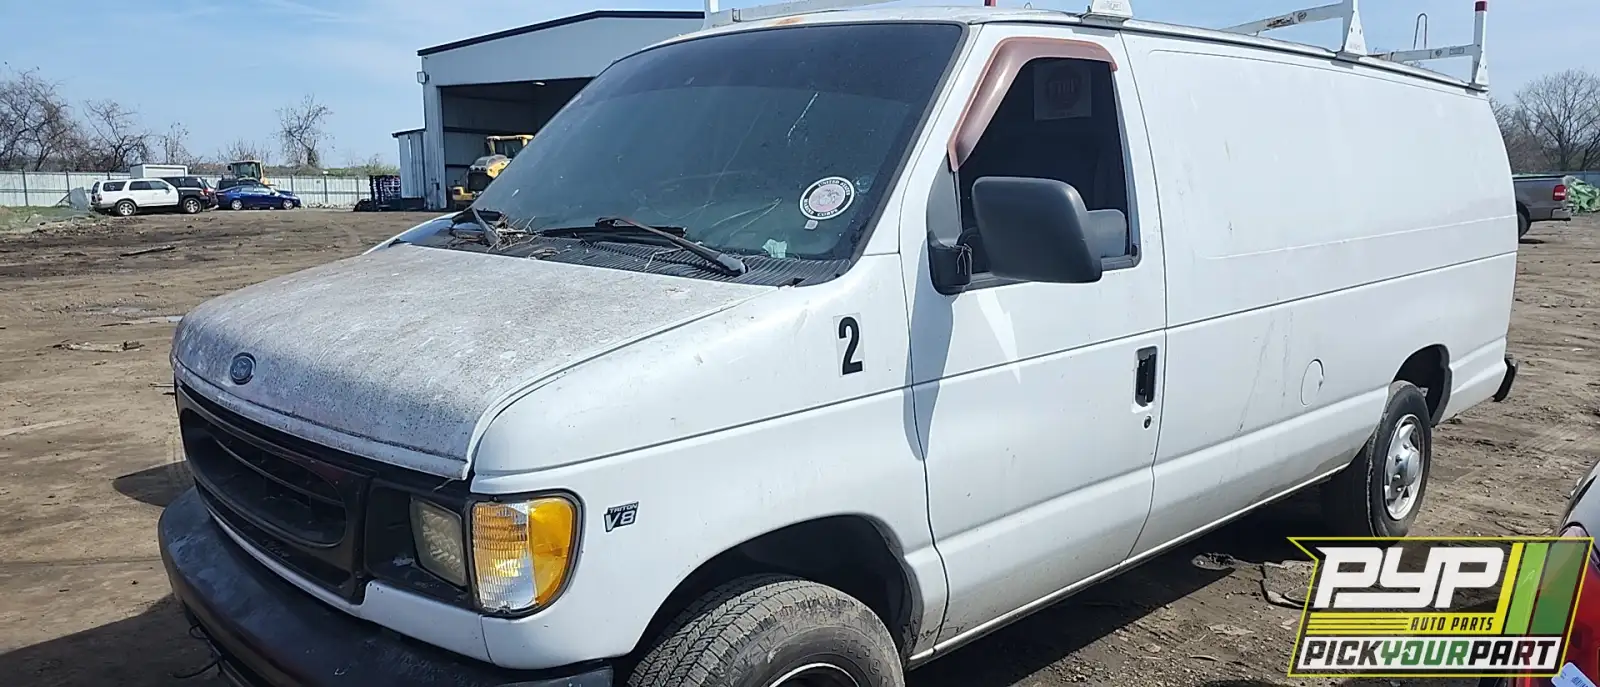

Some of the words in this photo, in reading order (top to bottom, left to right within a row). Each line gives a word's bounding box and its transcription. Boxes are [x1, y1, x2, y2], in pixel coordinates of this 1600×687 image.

[838, 316, 863, 376] 2
[609, 504, 638, 513] TRITON
[605, 510, 636, 531] V8
